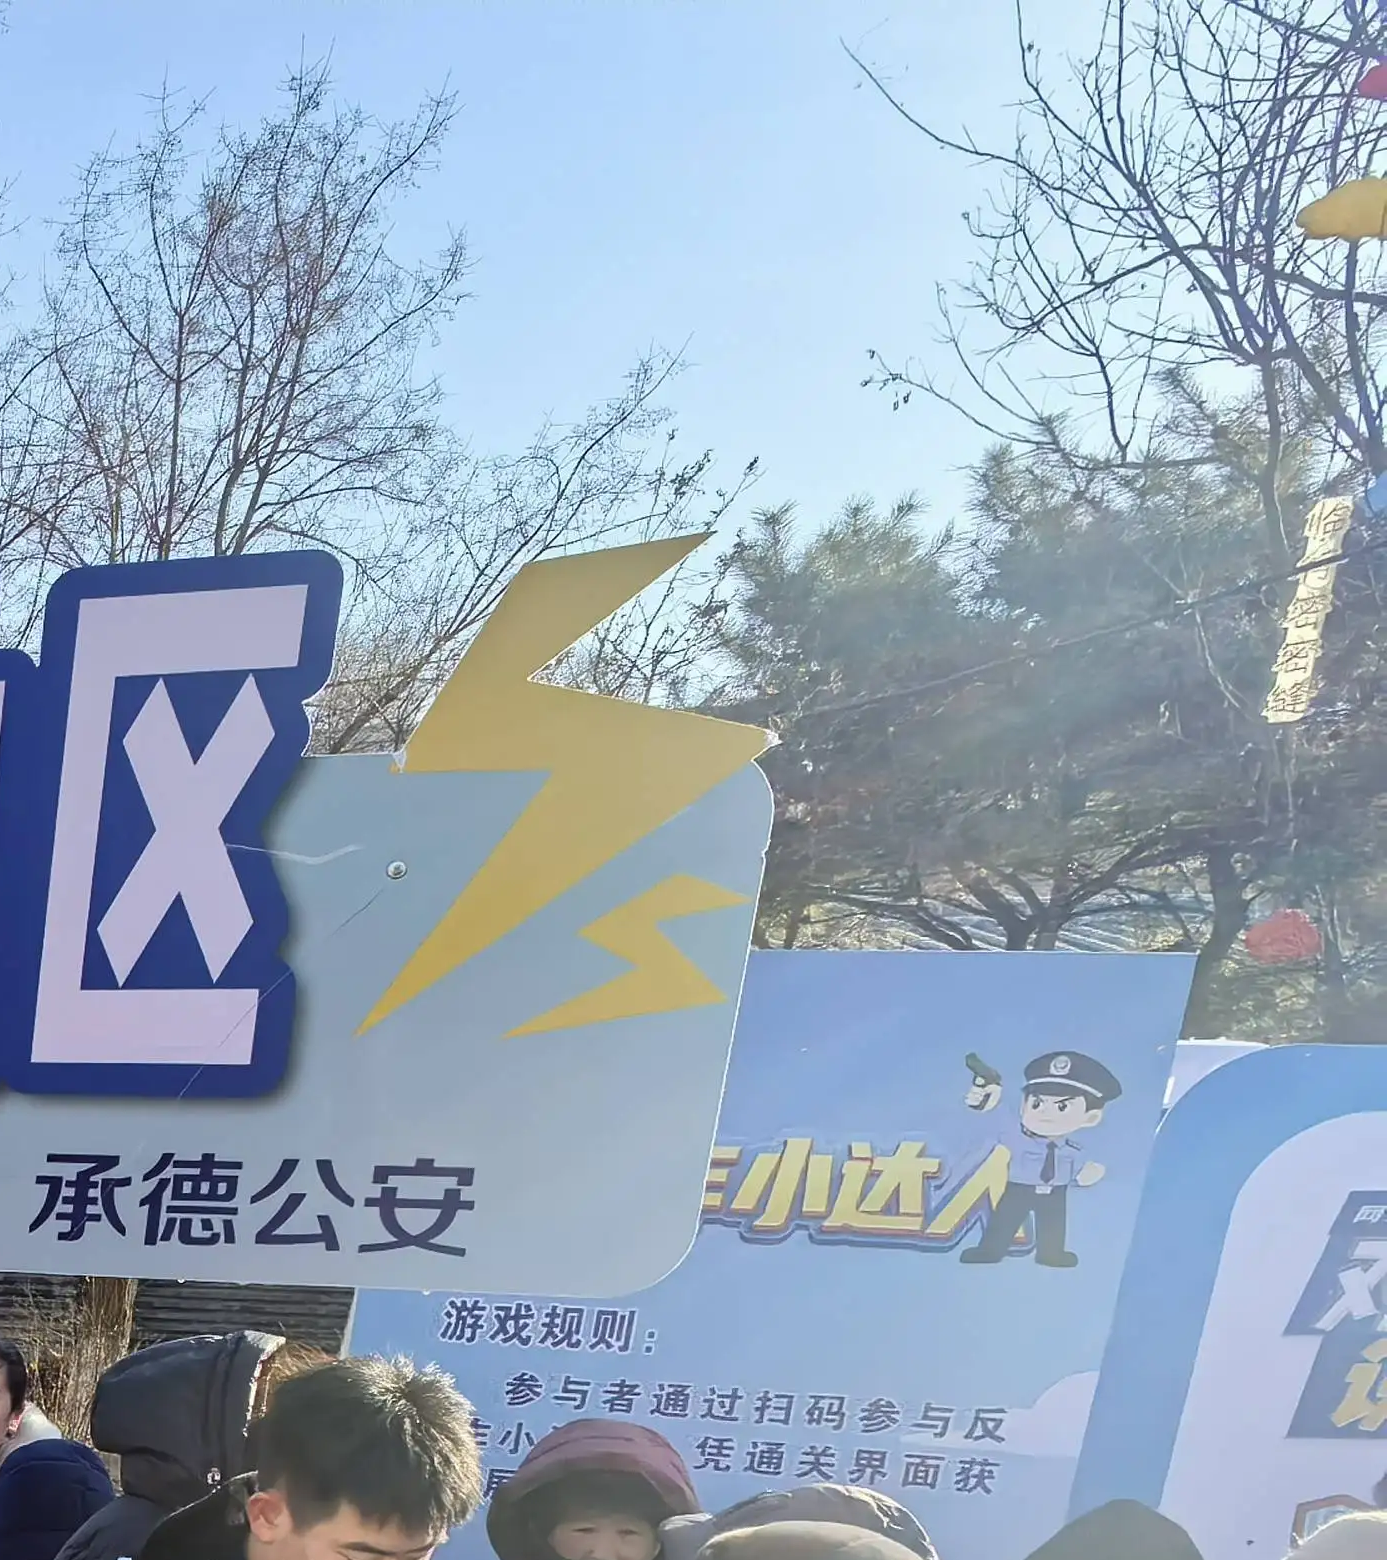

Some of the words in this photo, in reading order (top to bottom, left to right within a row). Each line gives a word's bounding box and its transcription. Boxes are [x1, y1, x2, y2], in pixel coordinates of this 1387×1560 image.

[28, 1152, 476, 1257] 承德公安
[505, 1371, 1008, 1444] 参与者通过扫码参与反
[692, 1435, 1002, 1496] 凭通关界面获
